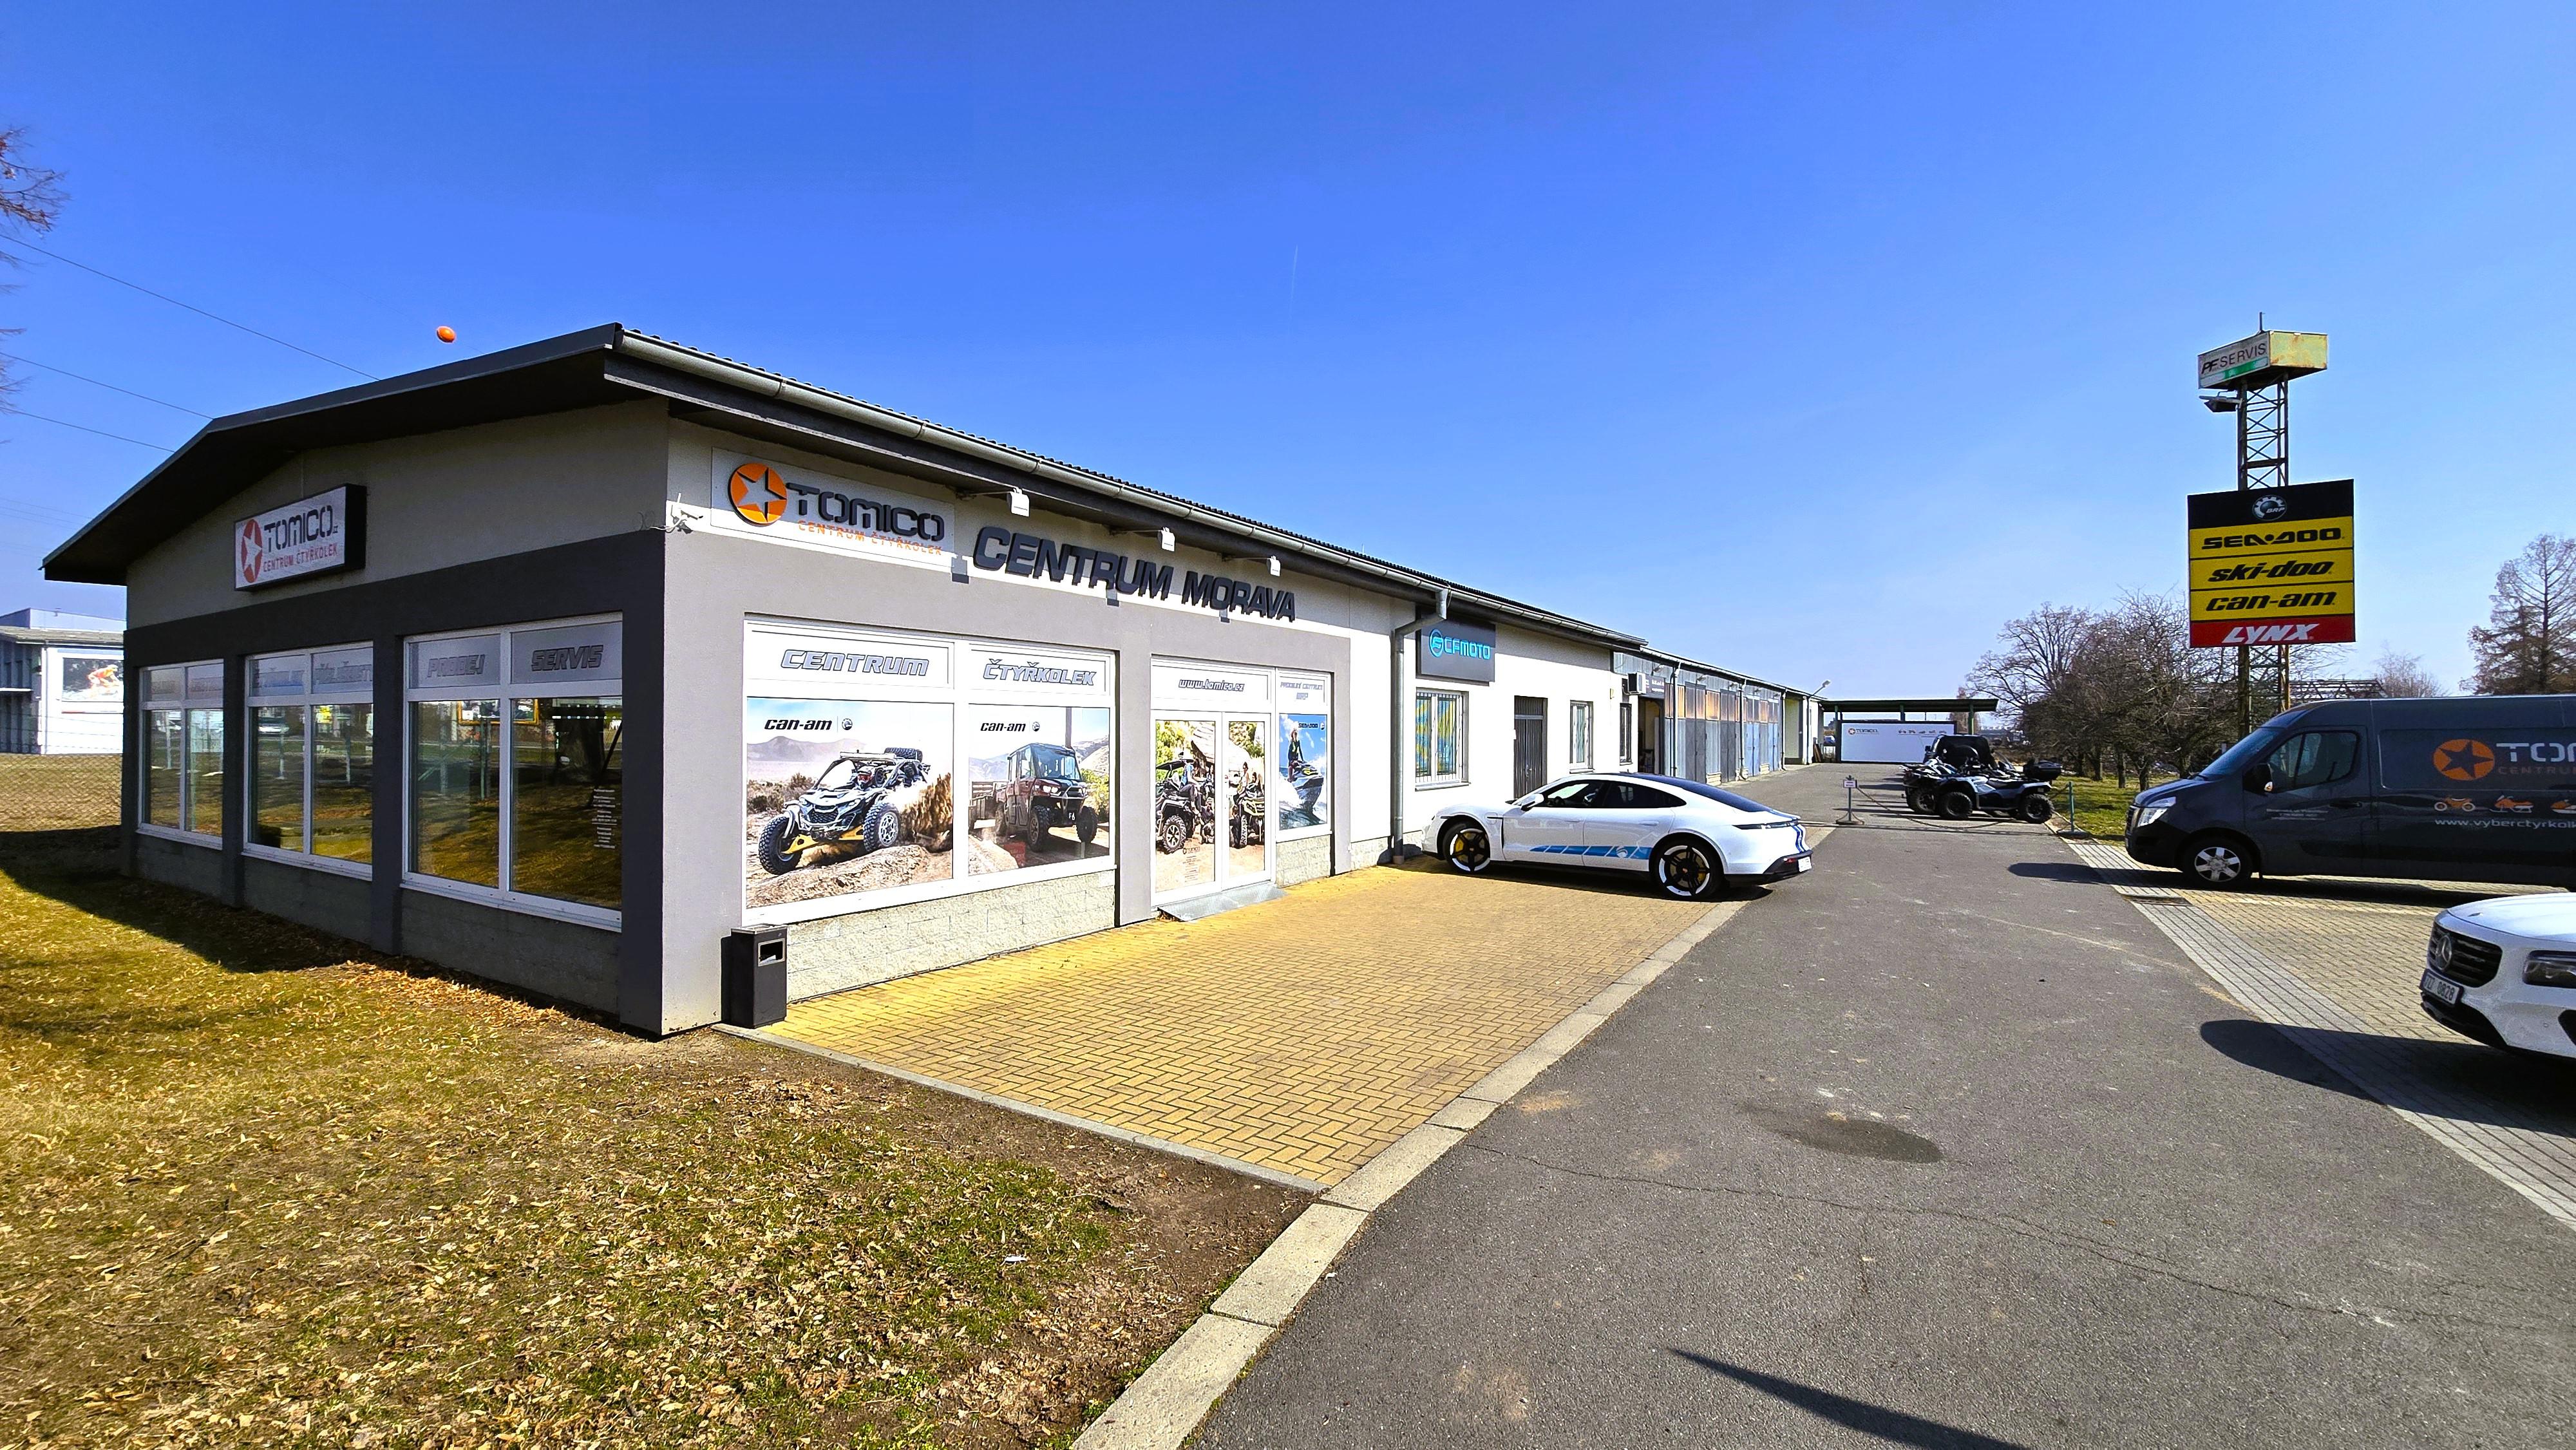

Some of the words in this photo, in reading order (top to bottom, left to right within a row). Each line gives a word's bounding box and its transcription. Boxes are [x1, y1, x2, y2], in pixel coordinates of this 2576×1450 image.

[786, 482, 944, 541] TOMICO
[797, 519, 865, 541] CENTRUM
[263, 554, 294, 572] CENTRUM
[973, 526, 1173, 600] CENTRUM
[1181, 570, 1296, 622] MORAVA
[2208, 560, 2335, 582] ski-doo
[2206, 590, 2336, 611] can-am
[2222, 623, 2320, 644] LYNX
[531, 645, 603, 672] SERVIS
[1443, 637, 1490, 659] CFMOTO
[781, 649, 929, 677] CENTRUM
[983, 659, 1097, 686] ČTYŘKOLEK
[1179, 679, 1245, 692] www.tomico.cz
[764, 719, 833, 731] can-am
[980, 722, 1027, 732] can-am
[2496, 742, 2576, 762] TO
